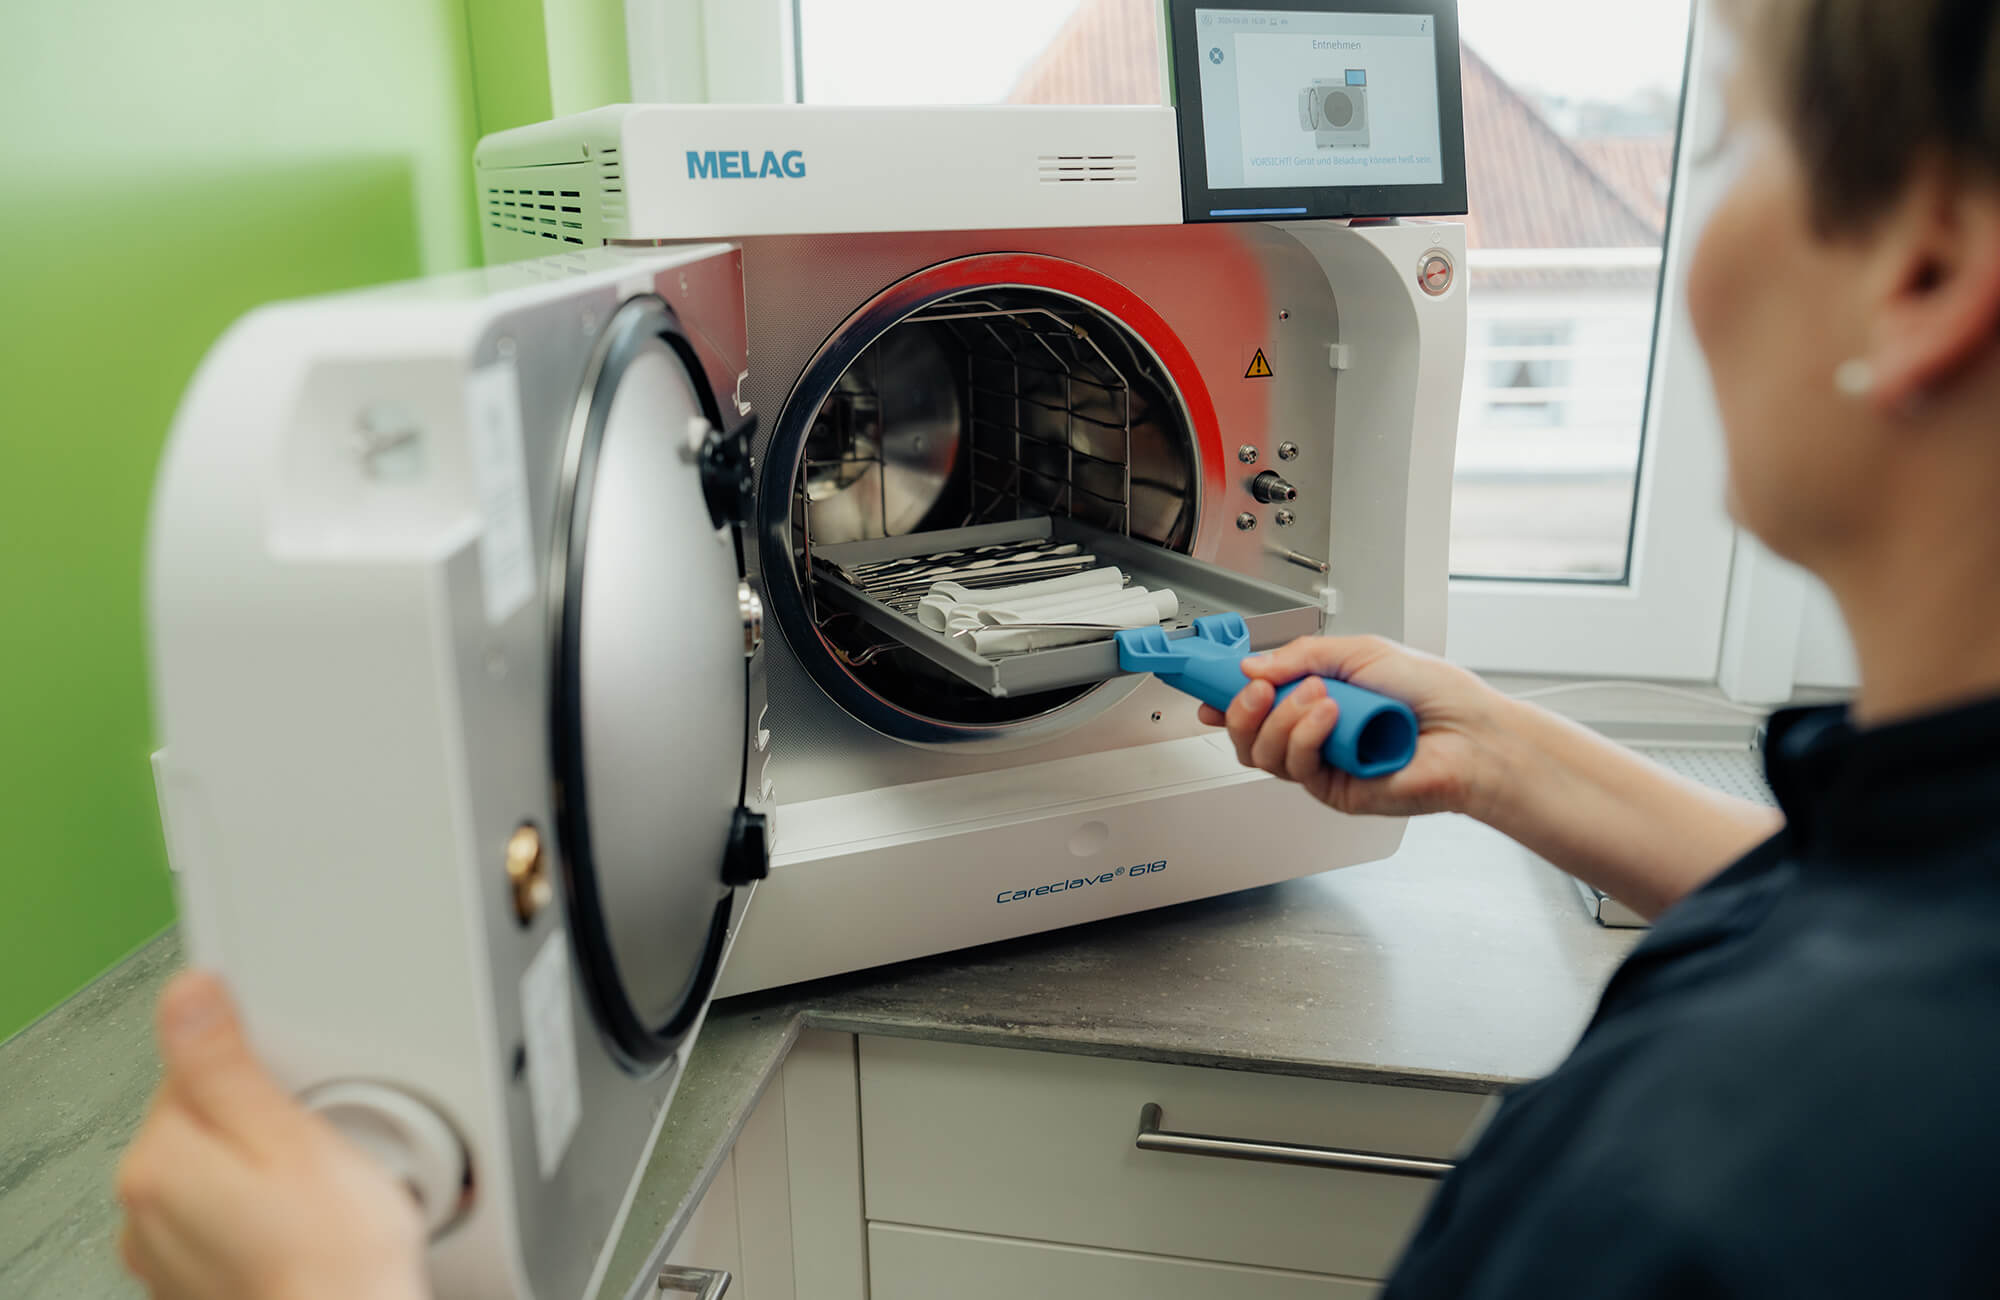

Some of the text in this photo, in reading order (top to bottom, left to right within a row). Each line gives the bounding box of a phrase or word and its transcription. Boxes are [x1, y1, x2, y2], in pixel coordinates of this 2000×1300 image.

[1312, 39, 1361, 50] Entnehmen
[686, 150, 806, 179] MELAG
[1316, 156, 1331, 166] und
[1129, 860, 1168, 877] 618
